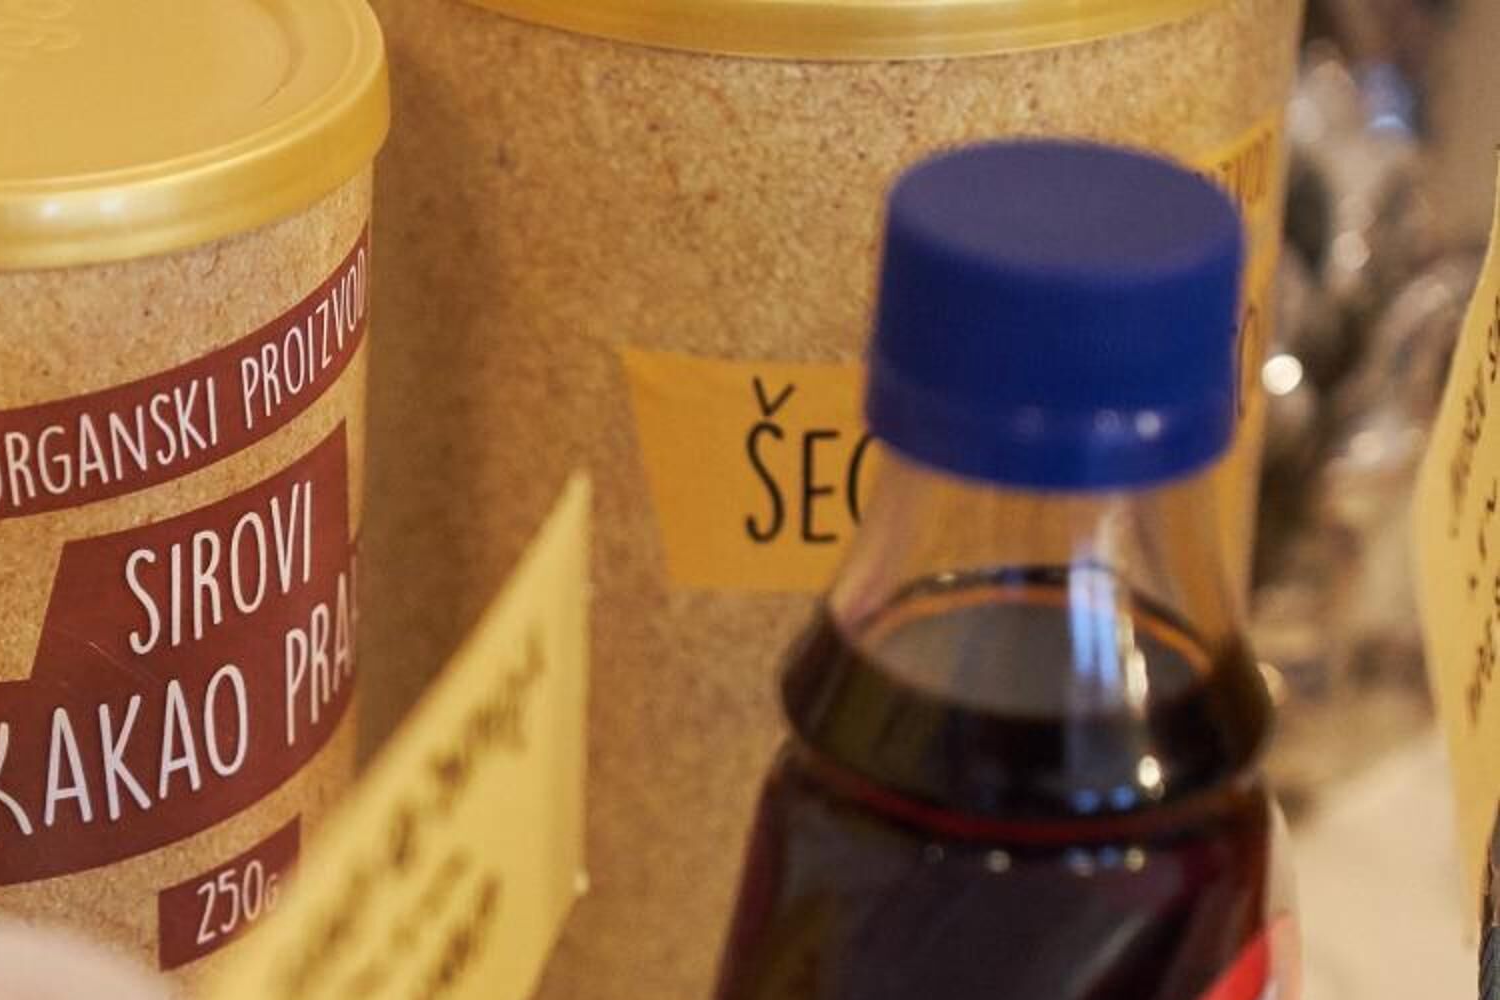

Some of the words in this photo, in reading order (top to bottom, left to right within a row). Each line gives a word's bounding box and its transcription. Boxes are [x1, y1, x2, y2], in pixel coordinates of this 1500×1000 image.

[240, 247, 367, 430] PROIZVOD
[124, 480, 313, 656] SIROVI
[285, 555, 358, 747] PRA
